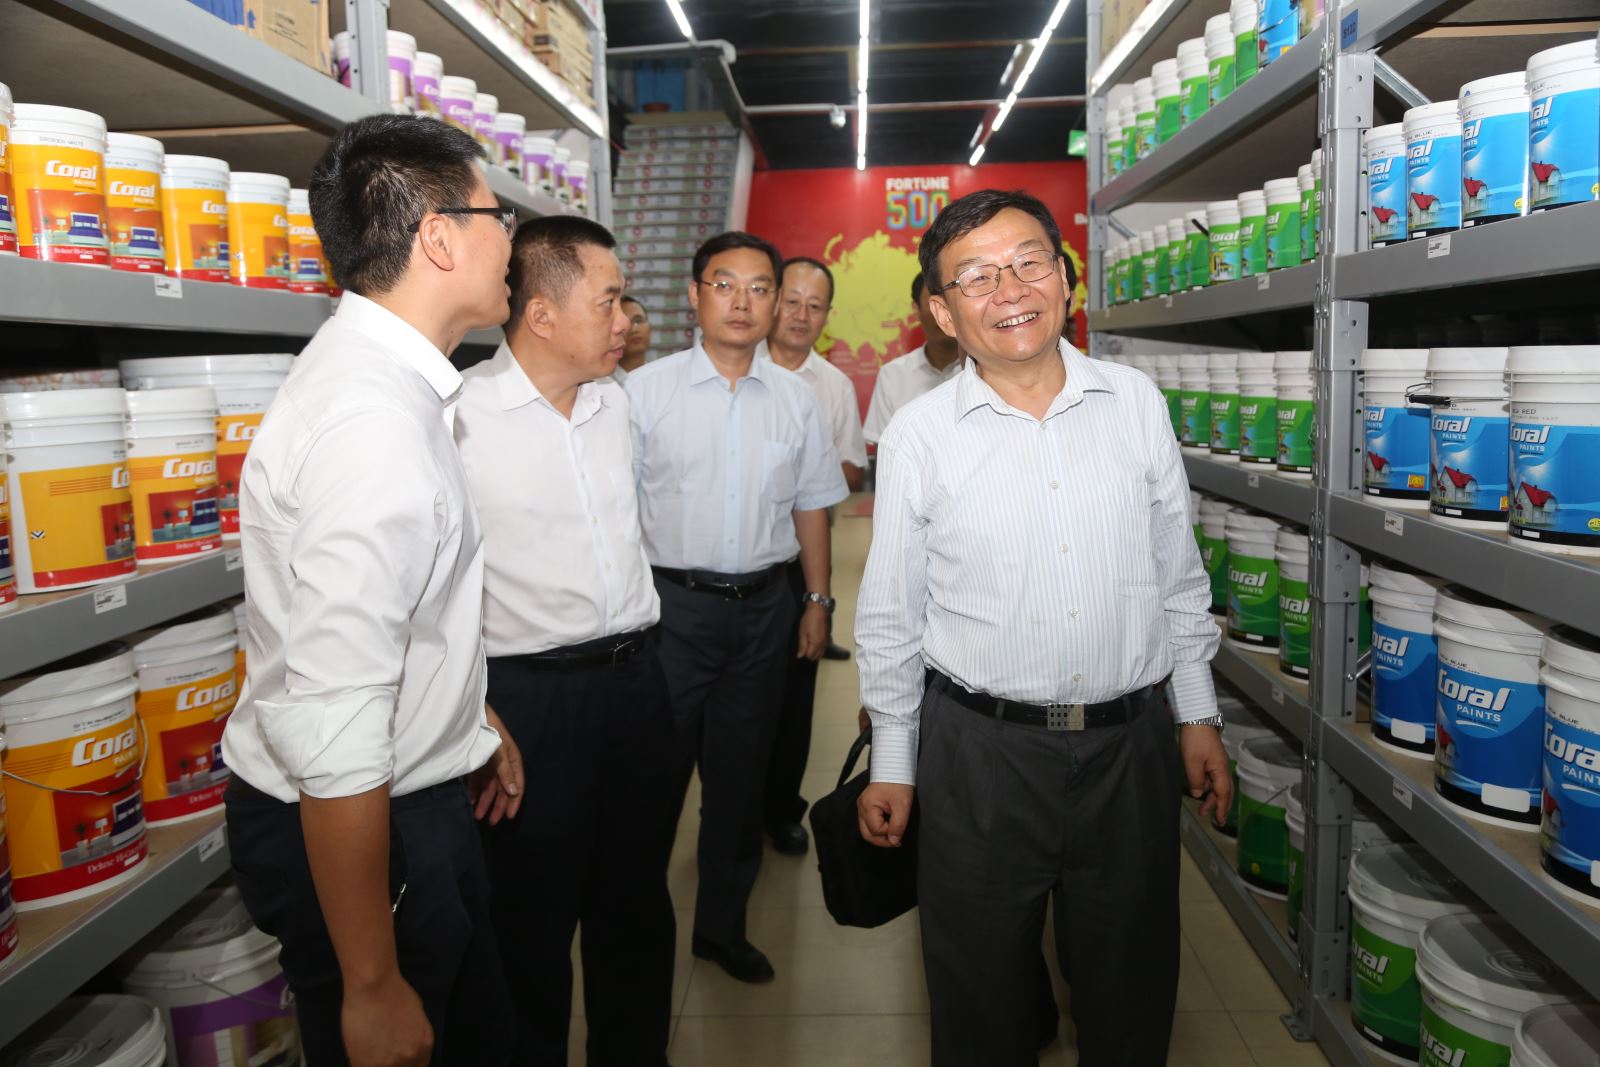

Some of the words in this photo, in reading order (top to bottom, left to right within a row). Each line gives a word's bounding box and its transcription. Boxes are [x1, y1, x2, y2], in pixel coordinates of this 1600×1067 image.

[1407, 139, 1433, 159] ral
[45, 159, 98, 181] Coral
[1369, 157, 1393, 176] ral
[109, 181, 156, 198] Coral
[885, 176, 949, 191] FORTUNE
[885, 190, 949, 230] 500
[1519, 444, 1546, 452] PAINTS
[1376, 651, 1404, 667] PAINTS
[1456, 703, 1501, 722] PAINTS
[1544, 721, 1600, 773] Cora
[1563, 764, 1600, 786] PAINT
